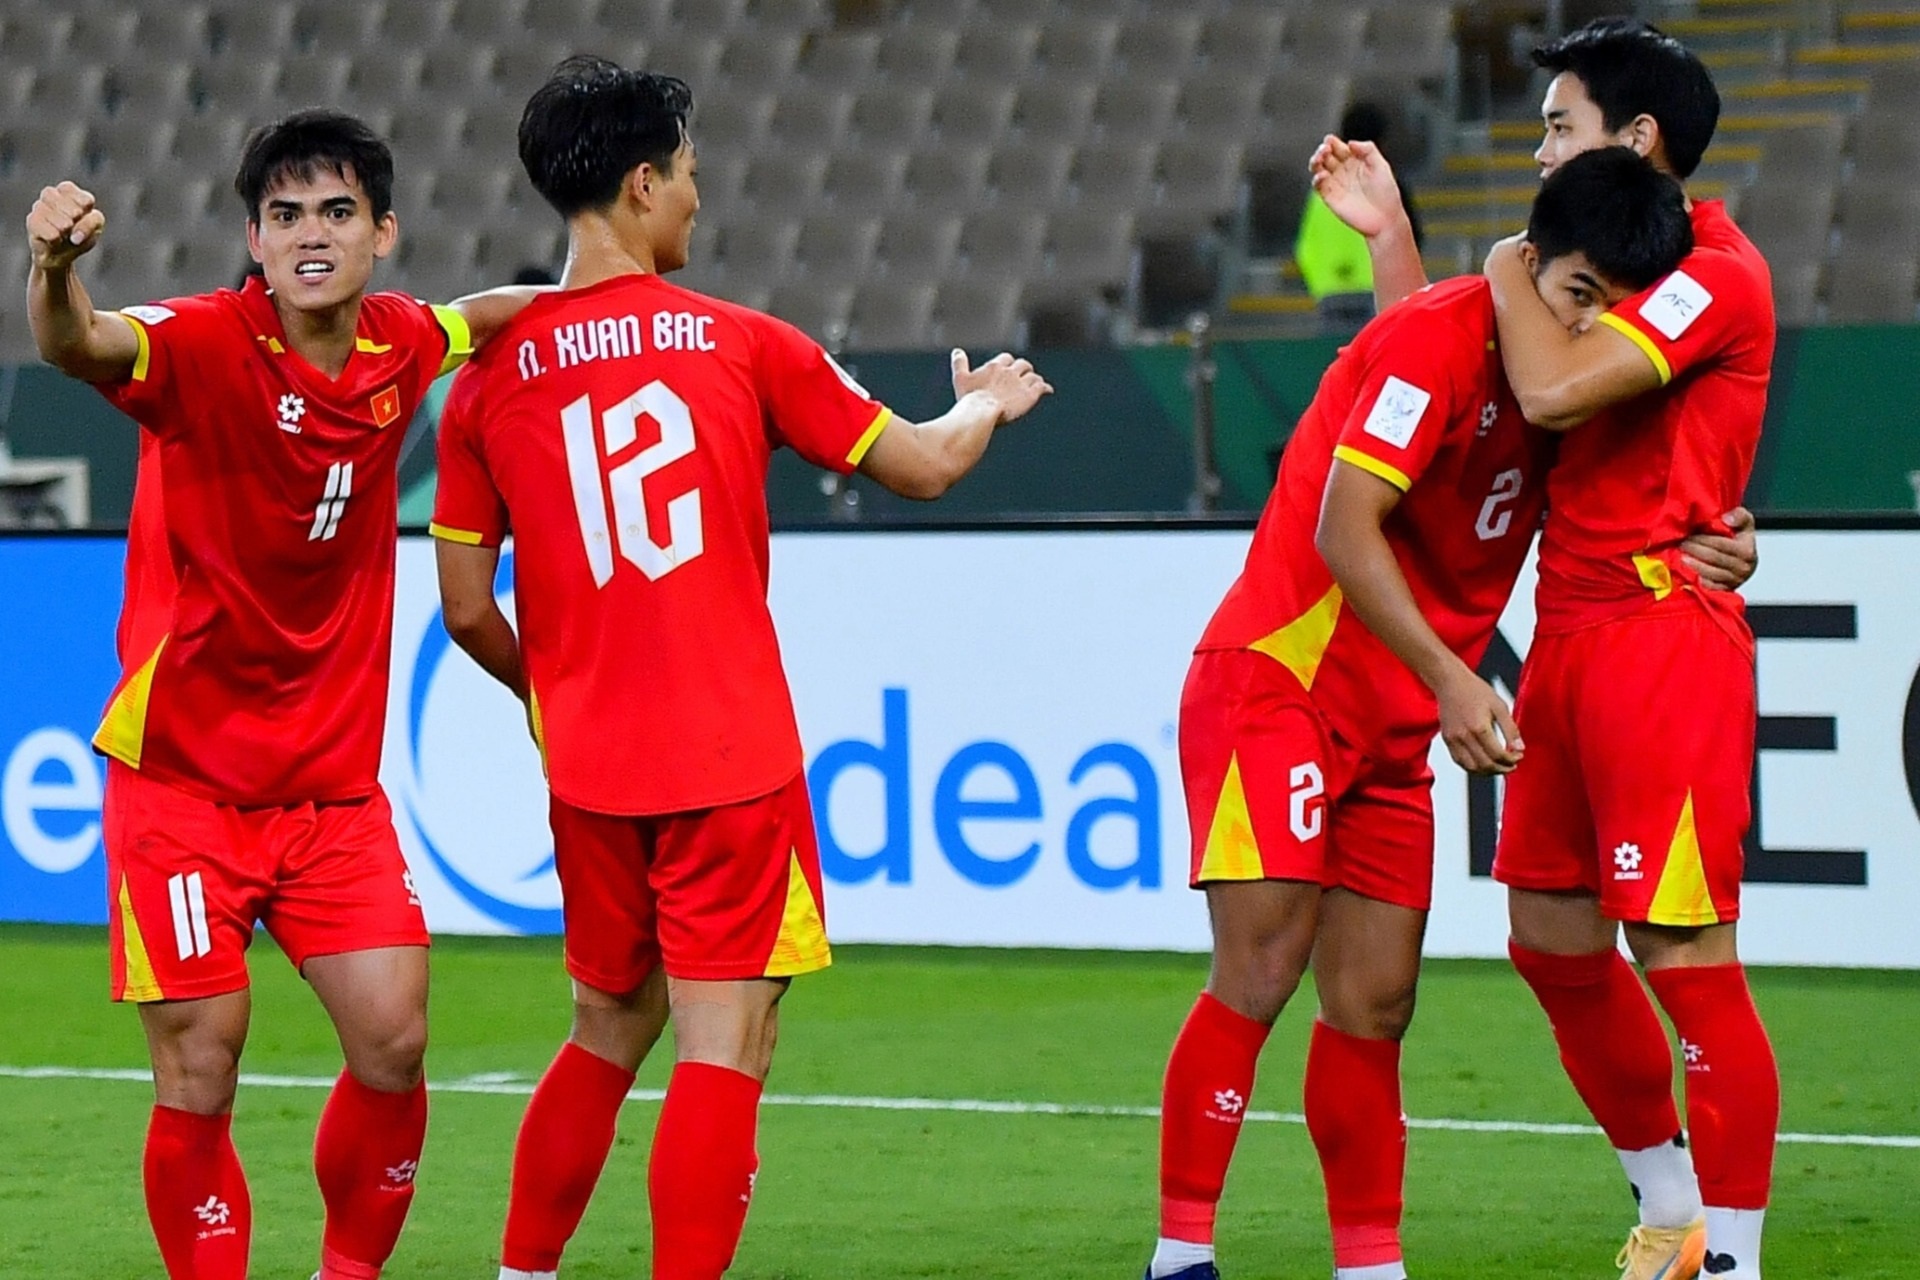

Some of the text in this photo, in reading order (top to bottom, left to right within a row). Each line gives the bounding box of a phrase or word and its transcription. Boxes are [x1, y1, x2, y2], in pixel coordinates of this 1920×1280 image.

[553, 314, 642, 368] XUAN
[652, 310, 716, 352] BAC
[308, 461, 353, 541] 11
[560, 379, 704, 590] 12
[1475, 468, 1523, 541] 2
[1289, 760, 1325, 843] 2
[168, 871, 211, 961] 11
